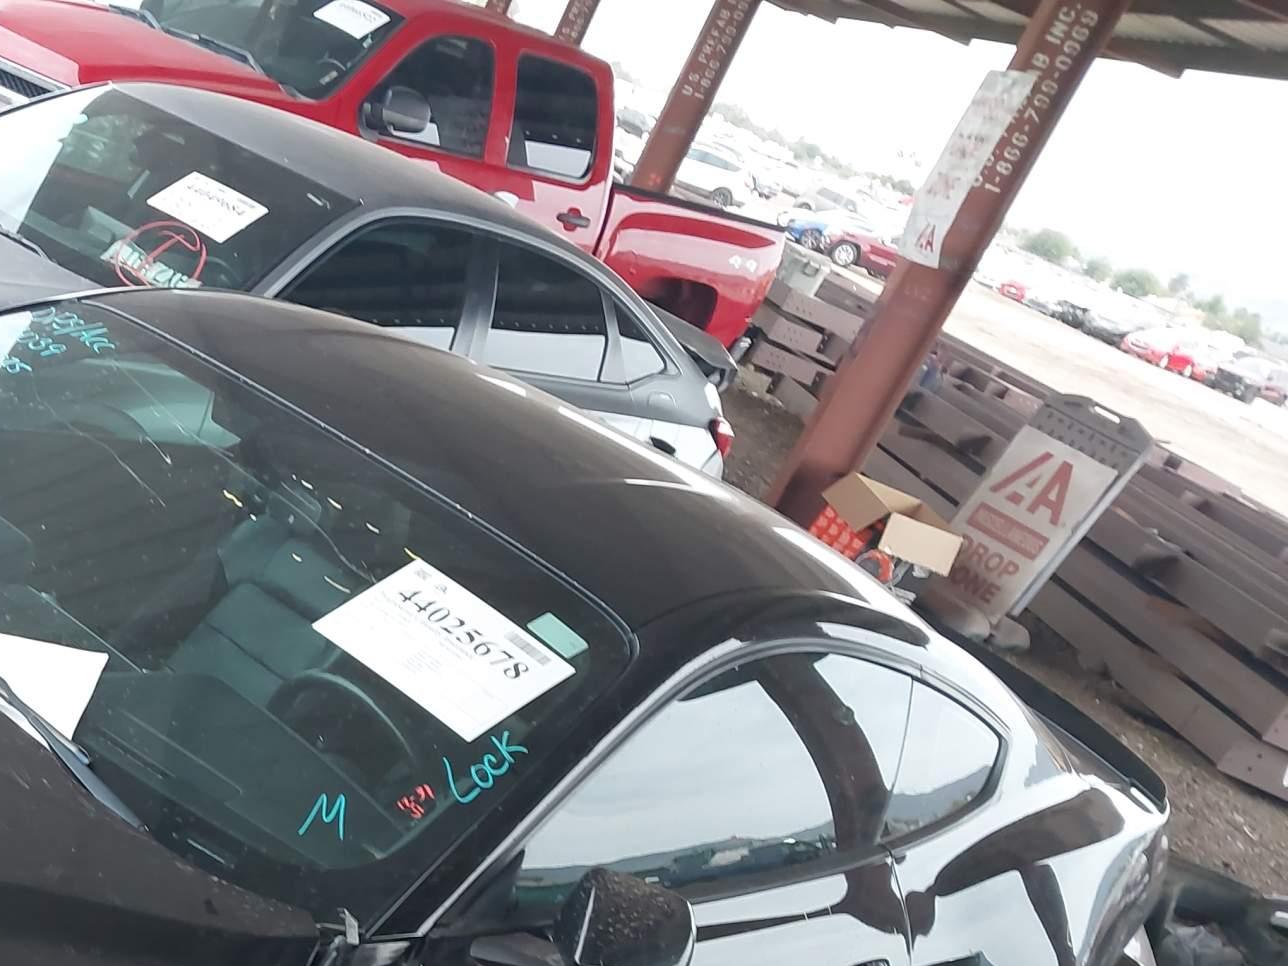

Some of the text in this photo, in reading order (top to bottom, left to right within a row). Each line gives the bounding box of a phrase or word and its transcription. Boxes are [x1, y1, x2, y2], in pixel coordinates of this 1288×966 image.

[1044, 0, 1083, 47] INC.
[950, 563, 1002, 604] ONE
[398, 589, 530, 681] 44025678
